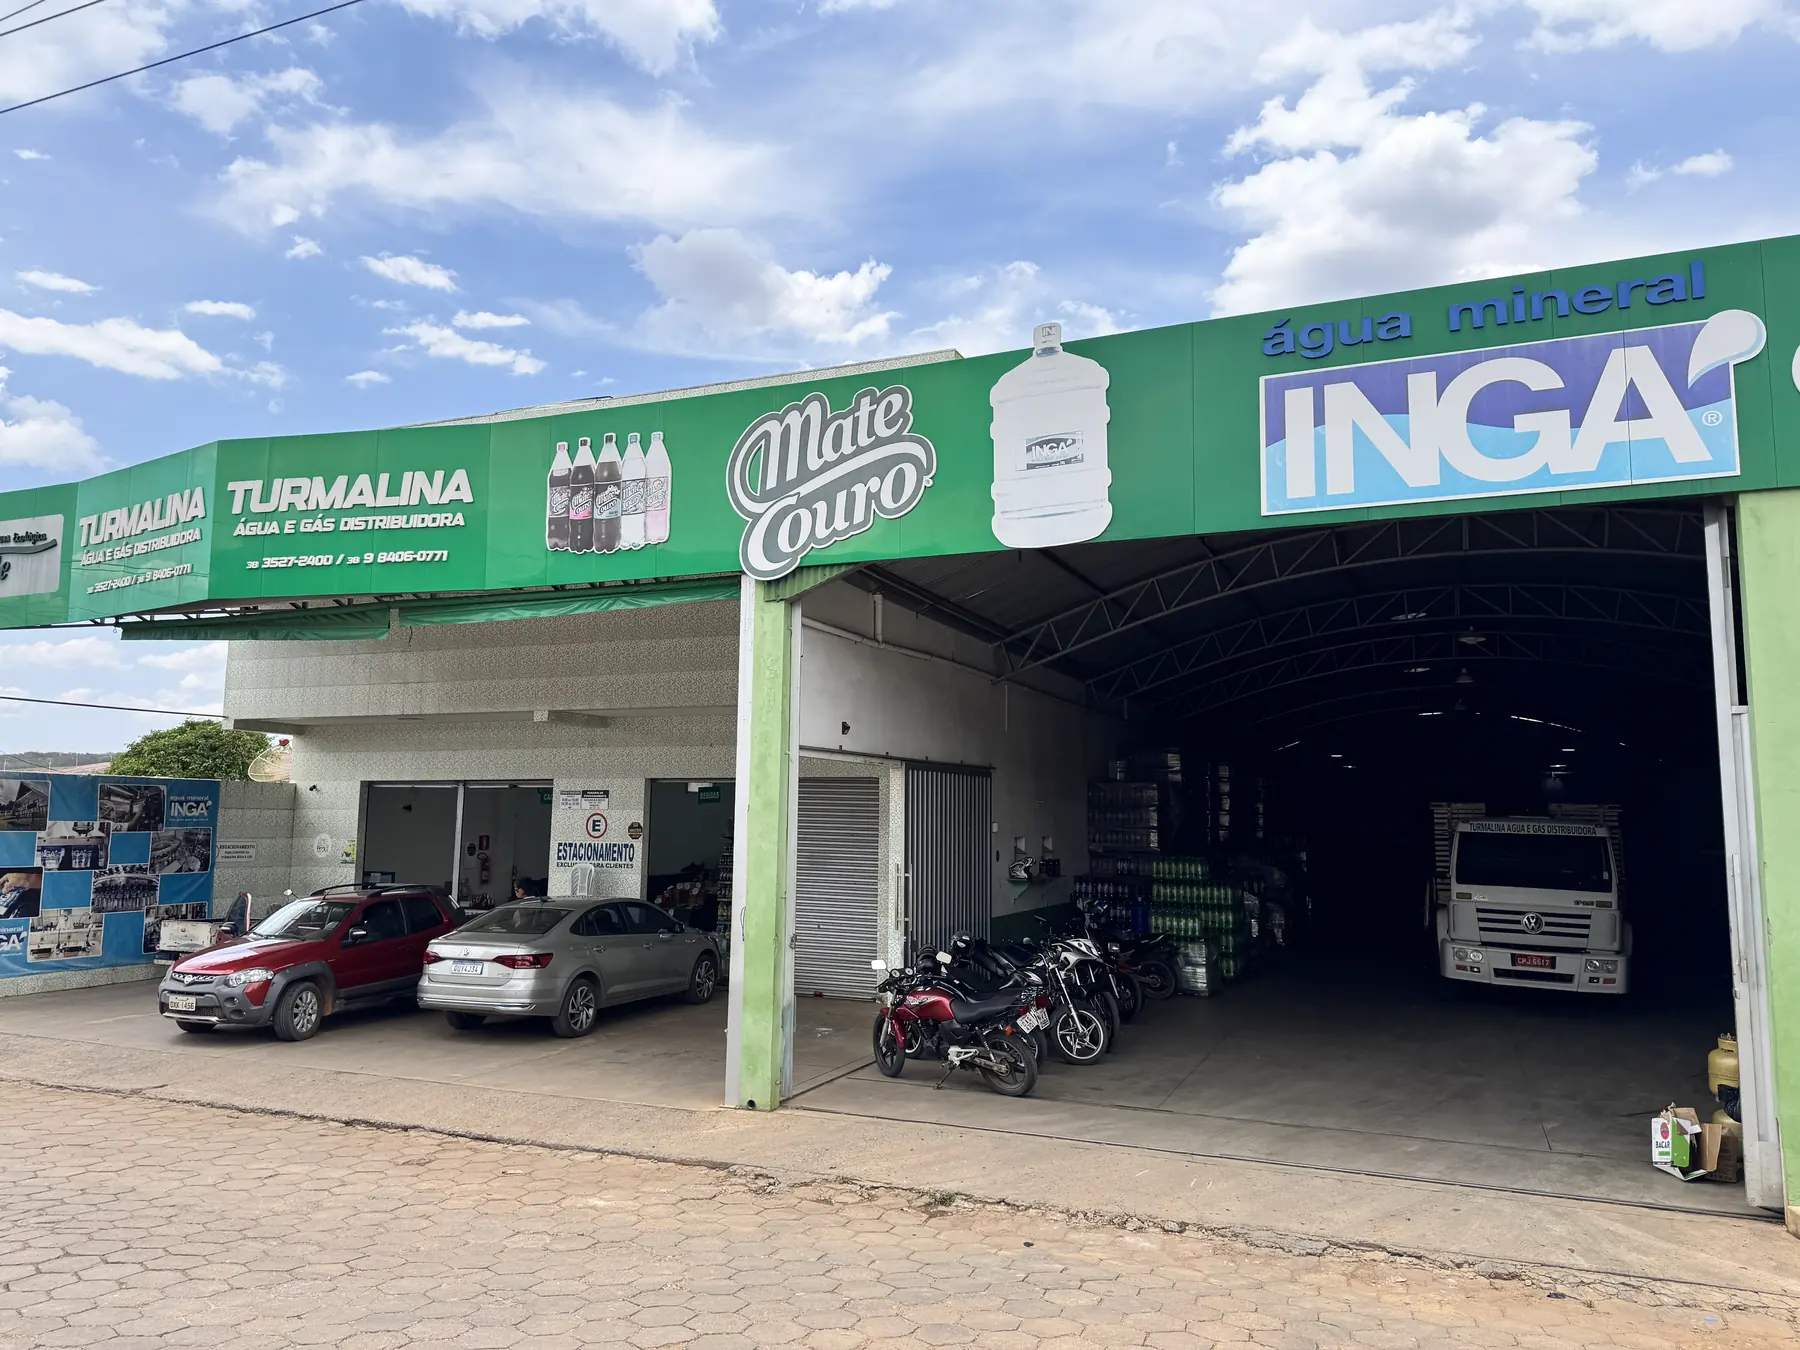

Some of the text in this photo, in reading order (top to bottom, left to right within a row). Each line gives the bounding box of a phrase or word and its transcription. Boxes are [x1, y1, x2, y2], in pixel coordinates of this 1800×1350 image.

[1262, 260, 1706, 359] água mineral
[734, 393, 904, 505] Mate
[227, 469, 474, 514] TURMALINA
[79, 486, 206, 548] TURMALINA
[233, 512, 465, 536] ÁGUA E GÁS DISTRIBUIDORA
[747, 462, 917, 571] Couro
[80, 528, 201, 566] ÁGUA E GÁS DISTRIBUIDORA
[246, 561, 259, 569] 38
[261, 554, 334, 569] 3527-2400
[346, 556, 360, 564] 38
[363, 552, 374, 563] 9
[377, 550, 448, 563] 8406-0771
[591, 819, 601, 833] E
[1469, 822, 1506, 833] TURMALINA
[1527, 824, 1531, 833] E
[1547, 824, 1597, 836] DISTRIBUIDORA
[557, 842, 635, 862] ESTACIONAMENTO
